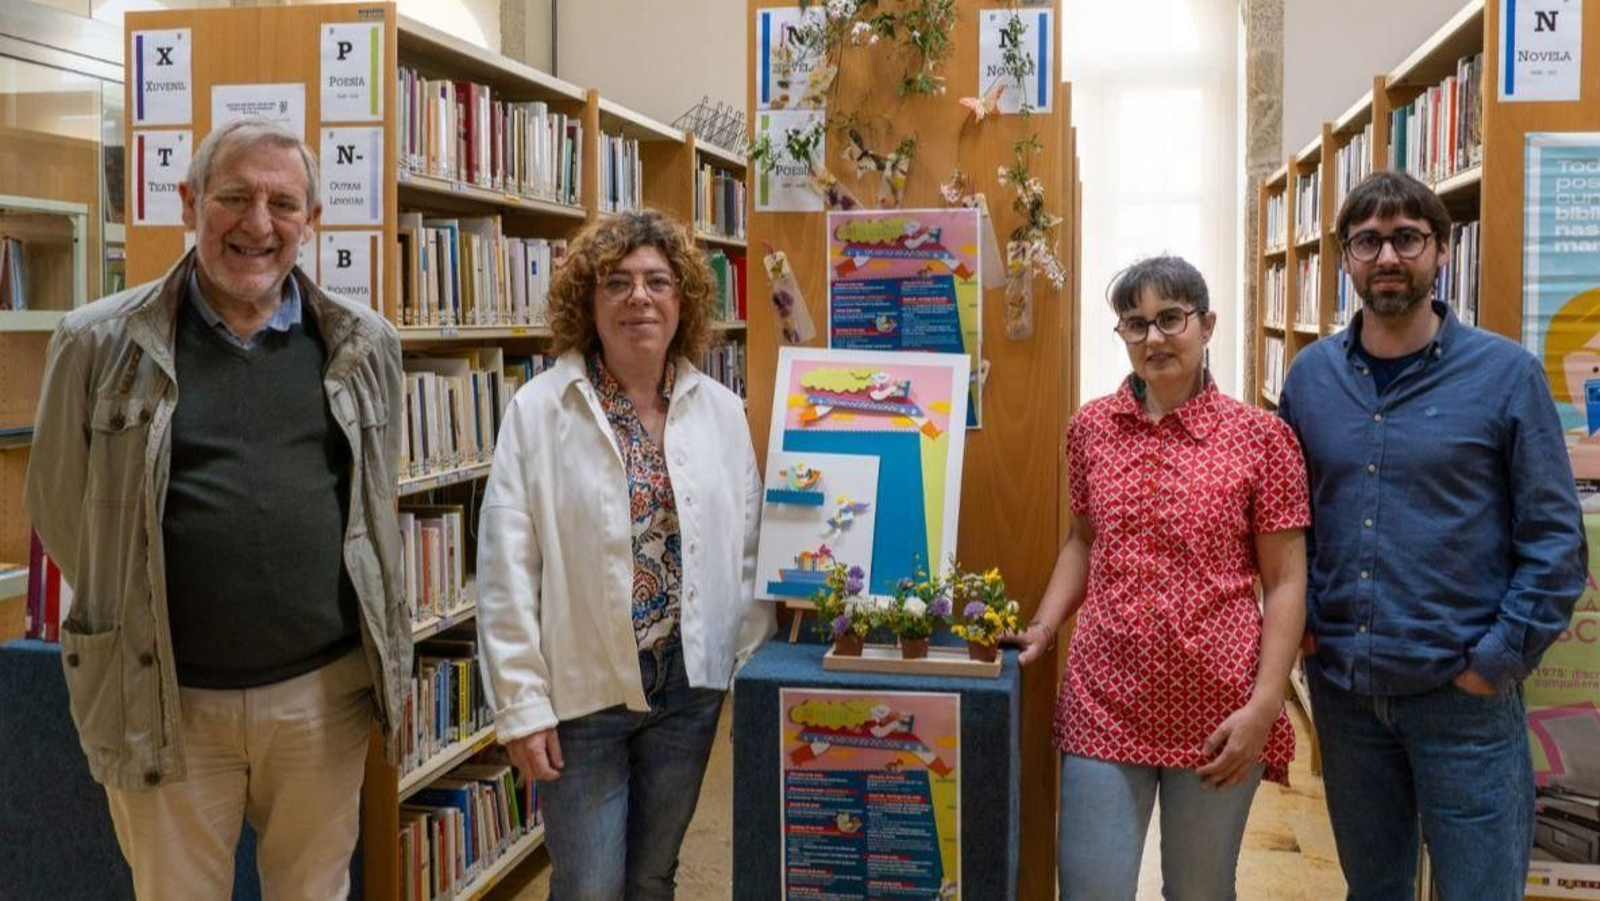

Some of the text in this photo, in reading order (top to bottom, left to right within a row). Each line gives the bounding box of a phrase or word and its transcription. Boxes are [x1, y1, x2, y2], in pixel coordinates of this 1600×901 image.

[1533, 10, 1559, 32] N
[156, 46, 173, 66] X
[336, 40, 353, 60] P
[157, 148, 173, 167] T
[336, 250, 351, 268] B
